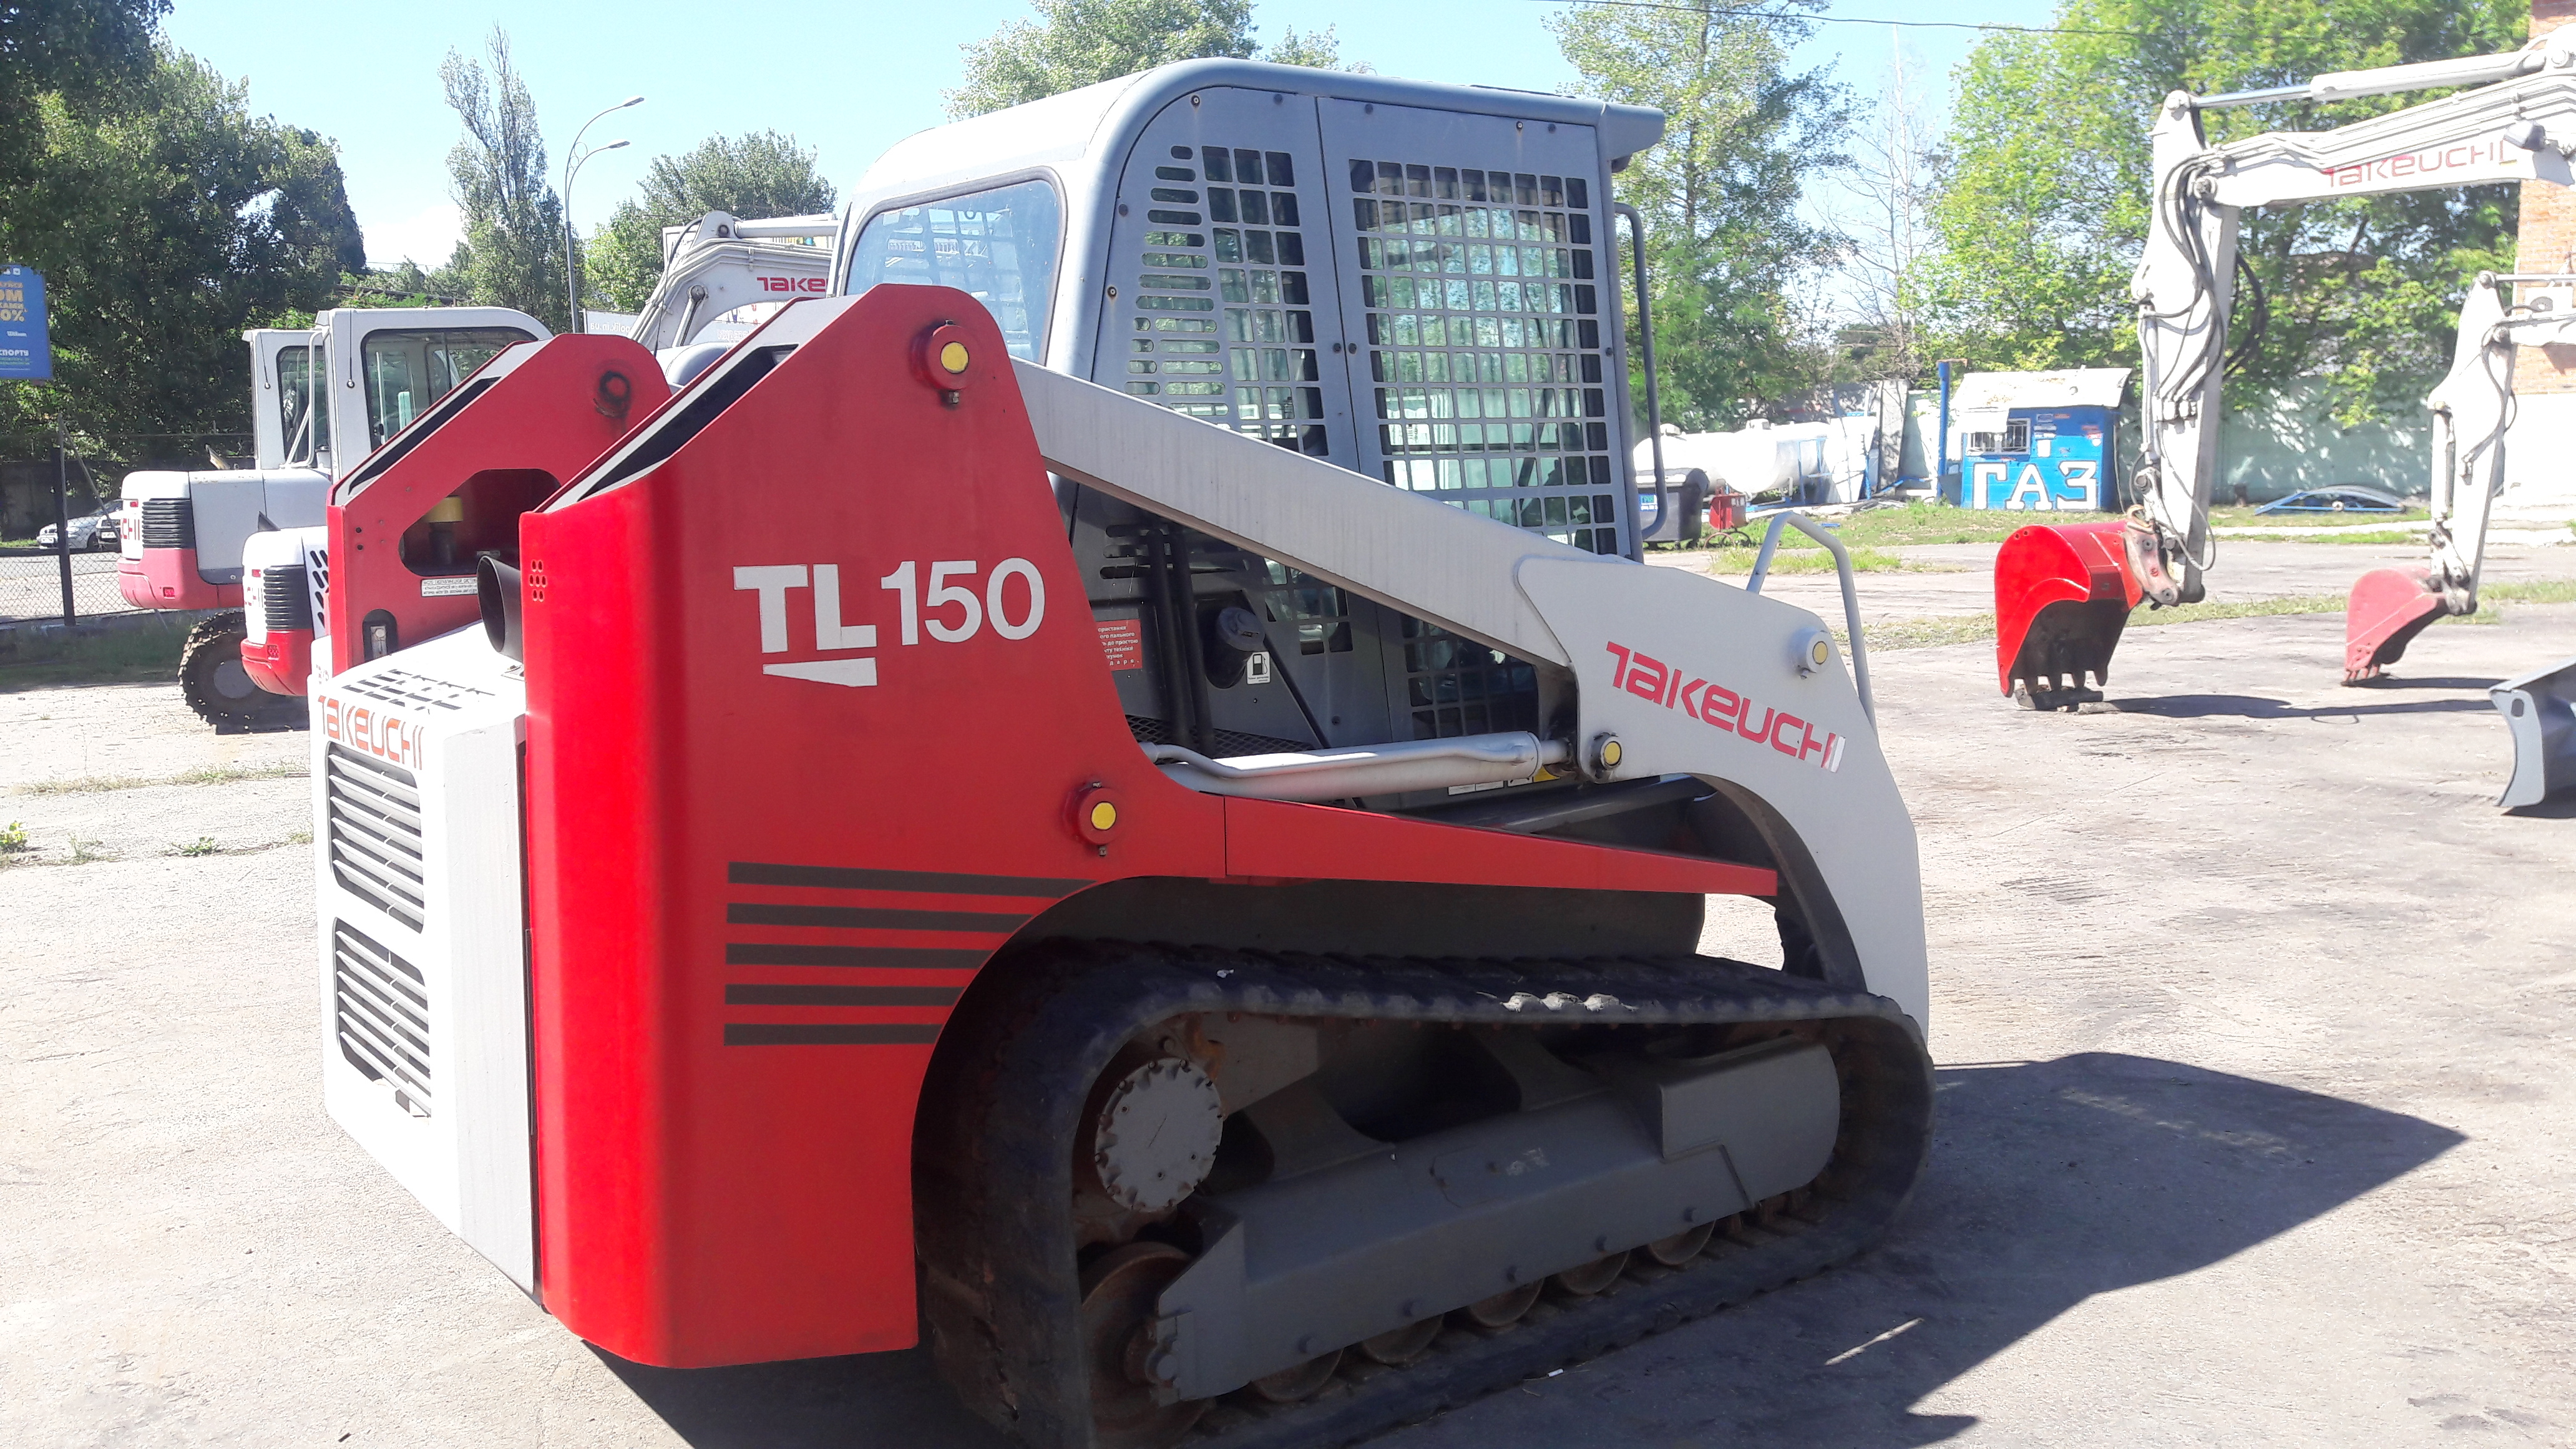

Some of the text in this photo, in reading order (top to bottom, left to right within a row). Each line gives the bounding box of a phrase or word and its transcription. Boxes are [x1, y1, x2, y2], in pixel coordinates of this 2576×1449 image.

[2321, 140, 2505, 187] TAKEUCHI
[756, 277, 828, 291] TAKE
[1973, 461, 2097, 510] ГАЗ
[733, 557, 1046, 654] TL 150
[318, 695, 425, 770] TAKEUCHI
[1606, 641, 1846, 773] TAKEUCHI
